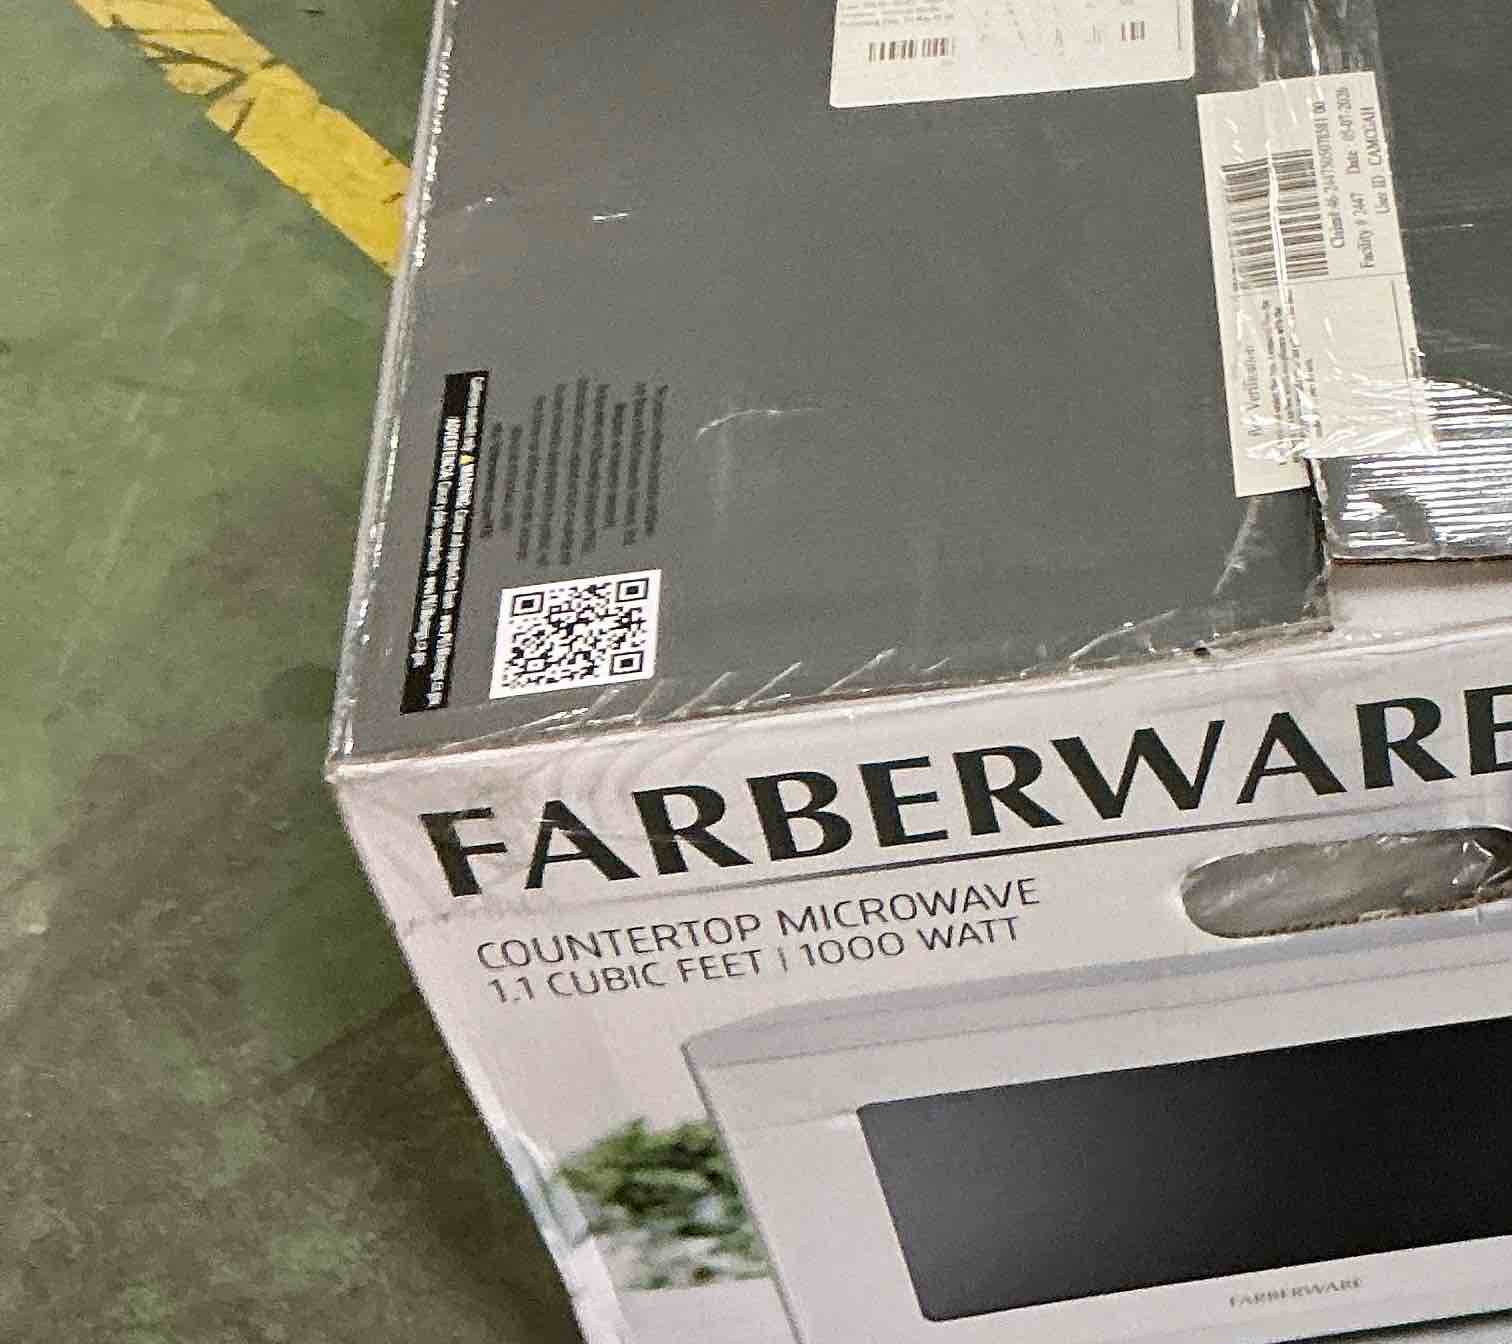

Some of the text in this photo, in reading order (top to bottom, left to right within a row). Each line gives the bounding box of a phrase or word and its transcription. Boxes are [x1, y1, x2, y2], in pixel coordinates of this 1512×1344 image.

[476, 877, 1042, 970] COUNTERTOP MICROWAVE
[488, 915, 1019, 1004] 1.1 CUBIC FEET 1000 WATT
